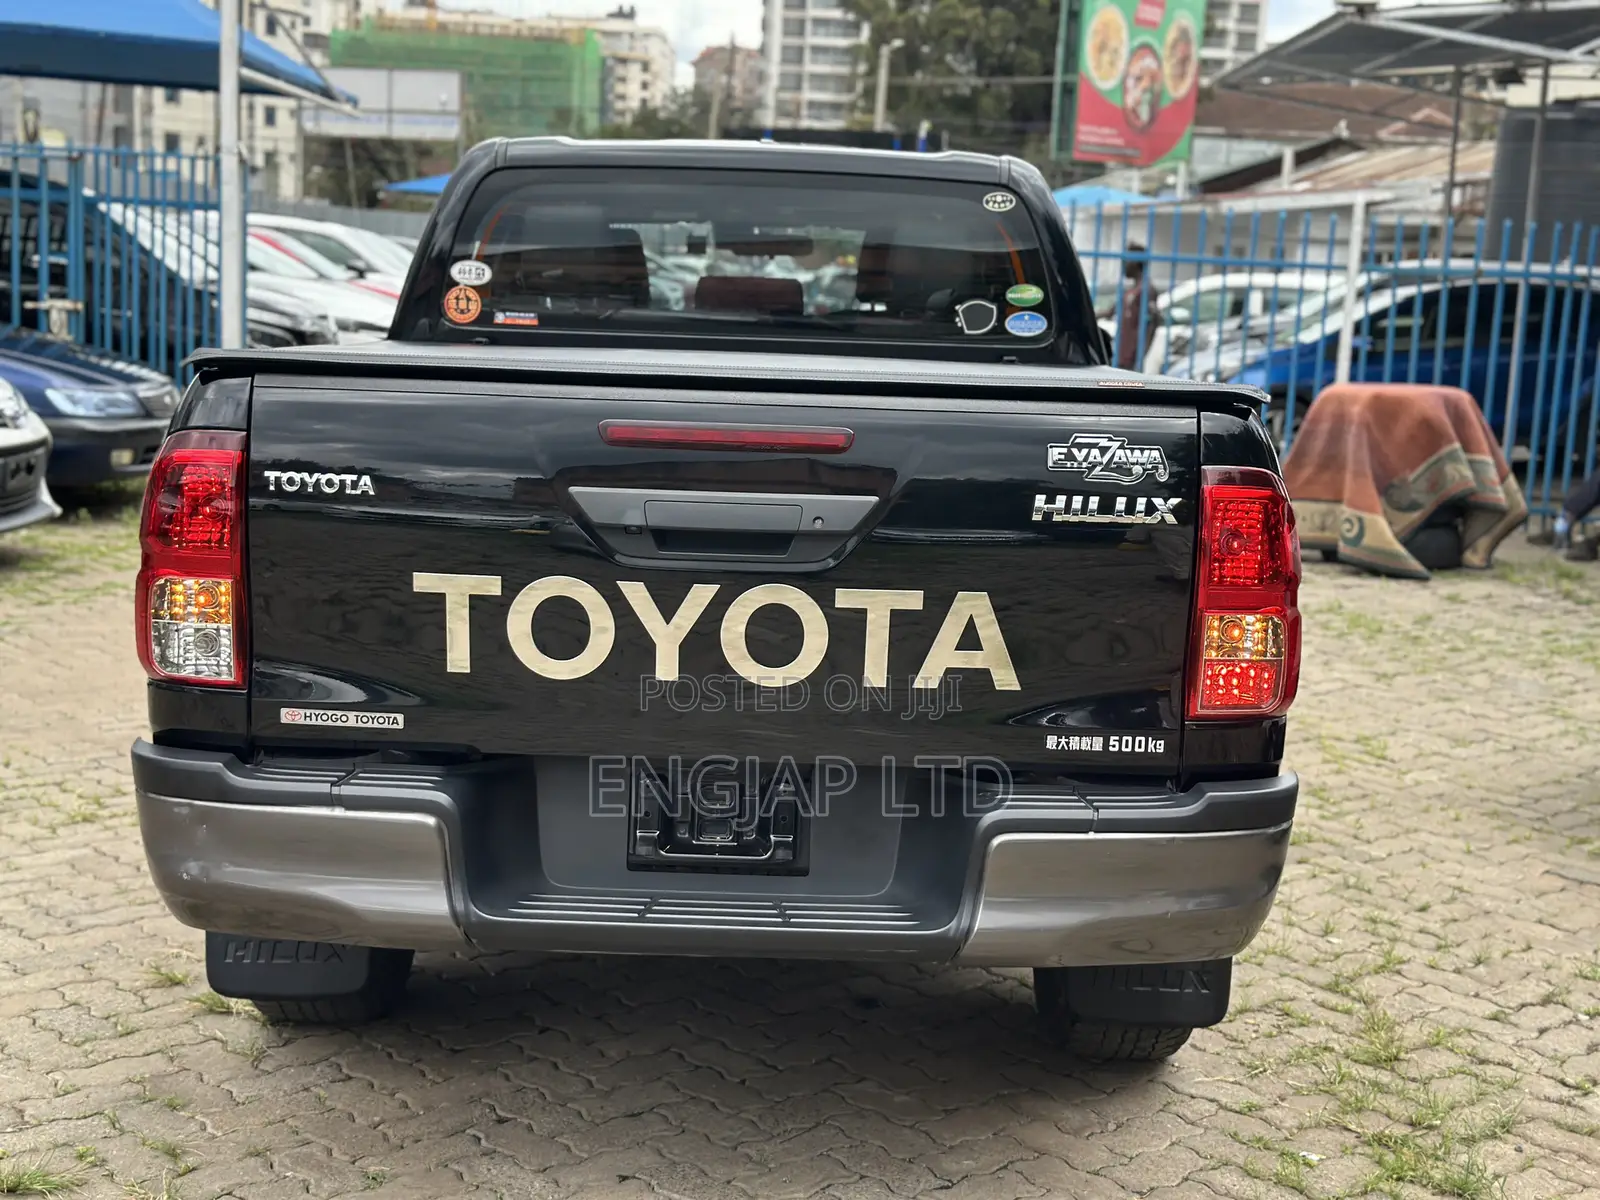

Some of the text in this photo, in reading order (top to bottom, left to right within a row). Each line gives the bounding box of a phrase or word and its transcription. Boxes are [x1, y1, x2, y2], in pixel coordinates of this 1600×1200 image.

[264, 470, 375, 496] TOYOTA
[1032, 494, 1182, 525] HILUX
[412, 571, 1022, 691] TOYOTA
[303, 711, 400, 726] HYOGO TOYOTA
[1046, 735, 1165, 753] 最大積載量 500kg
[224, 940, 346, 964] HILUX
